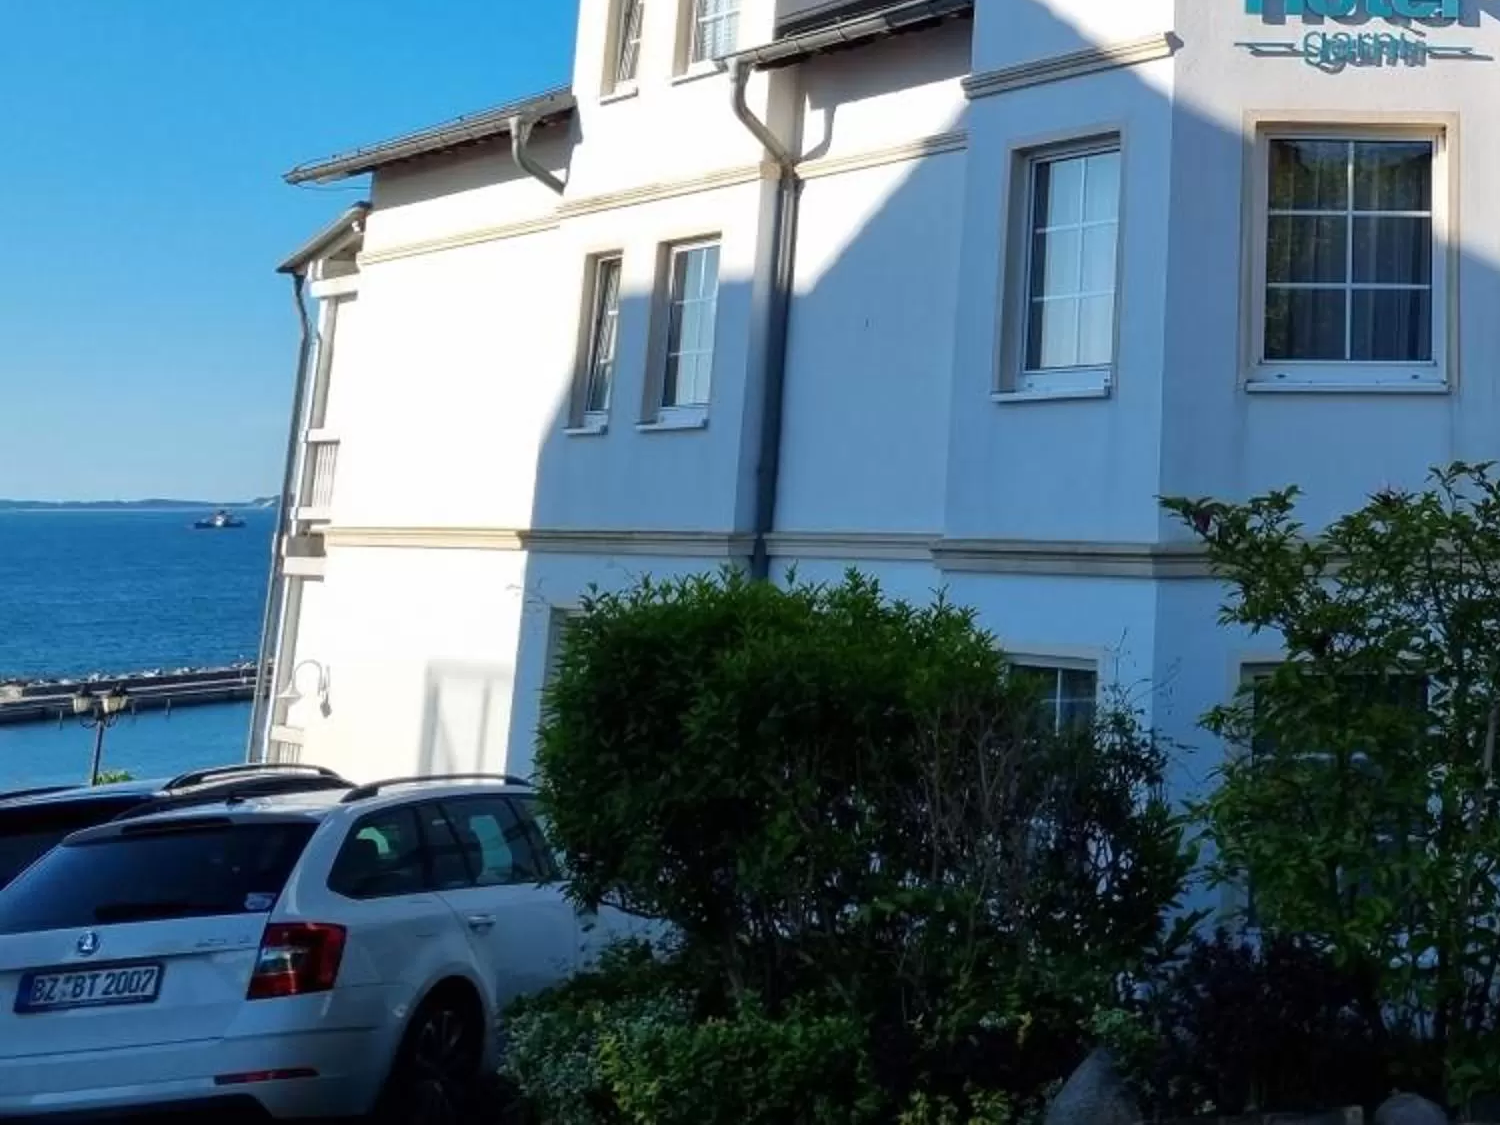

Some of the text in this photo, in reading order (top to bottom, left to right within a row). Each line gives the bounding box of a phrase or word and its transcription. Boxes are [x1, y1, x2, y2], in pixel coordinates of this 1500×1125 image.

[30, 969, 156, 1002] BZ BT 2007
